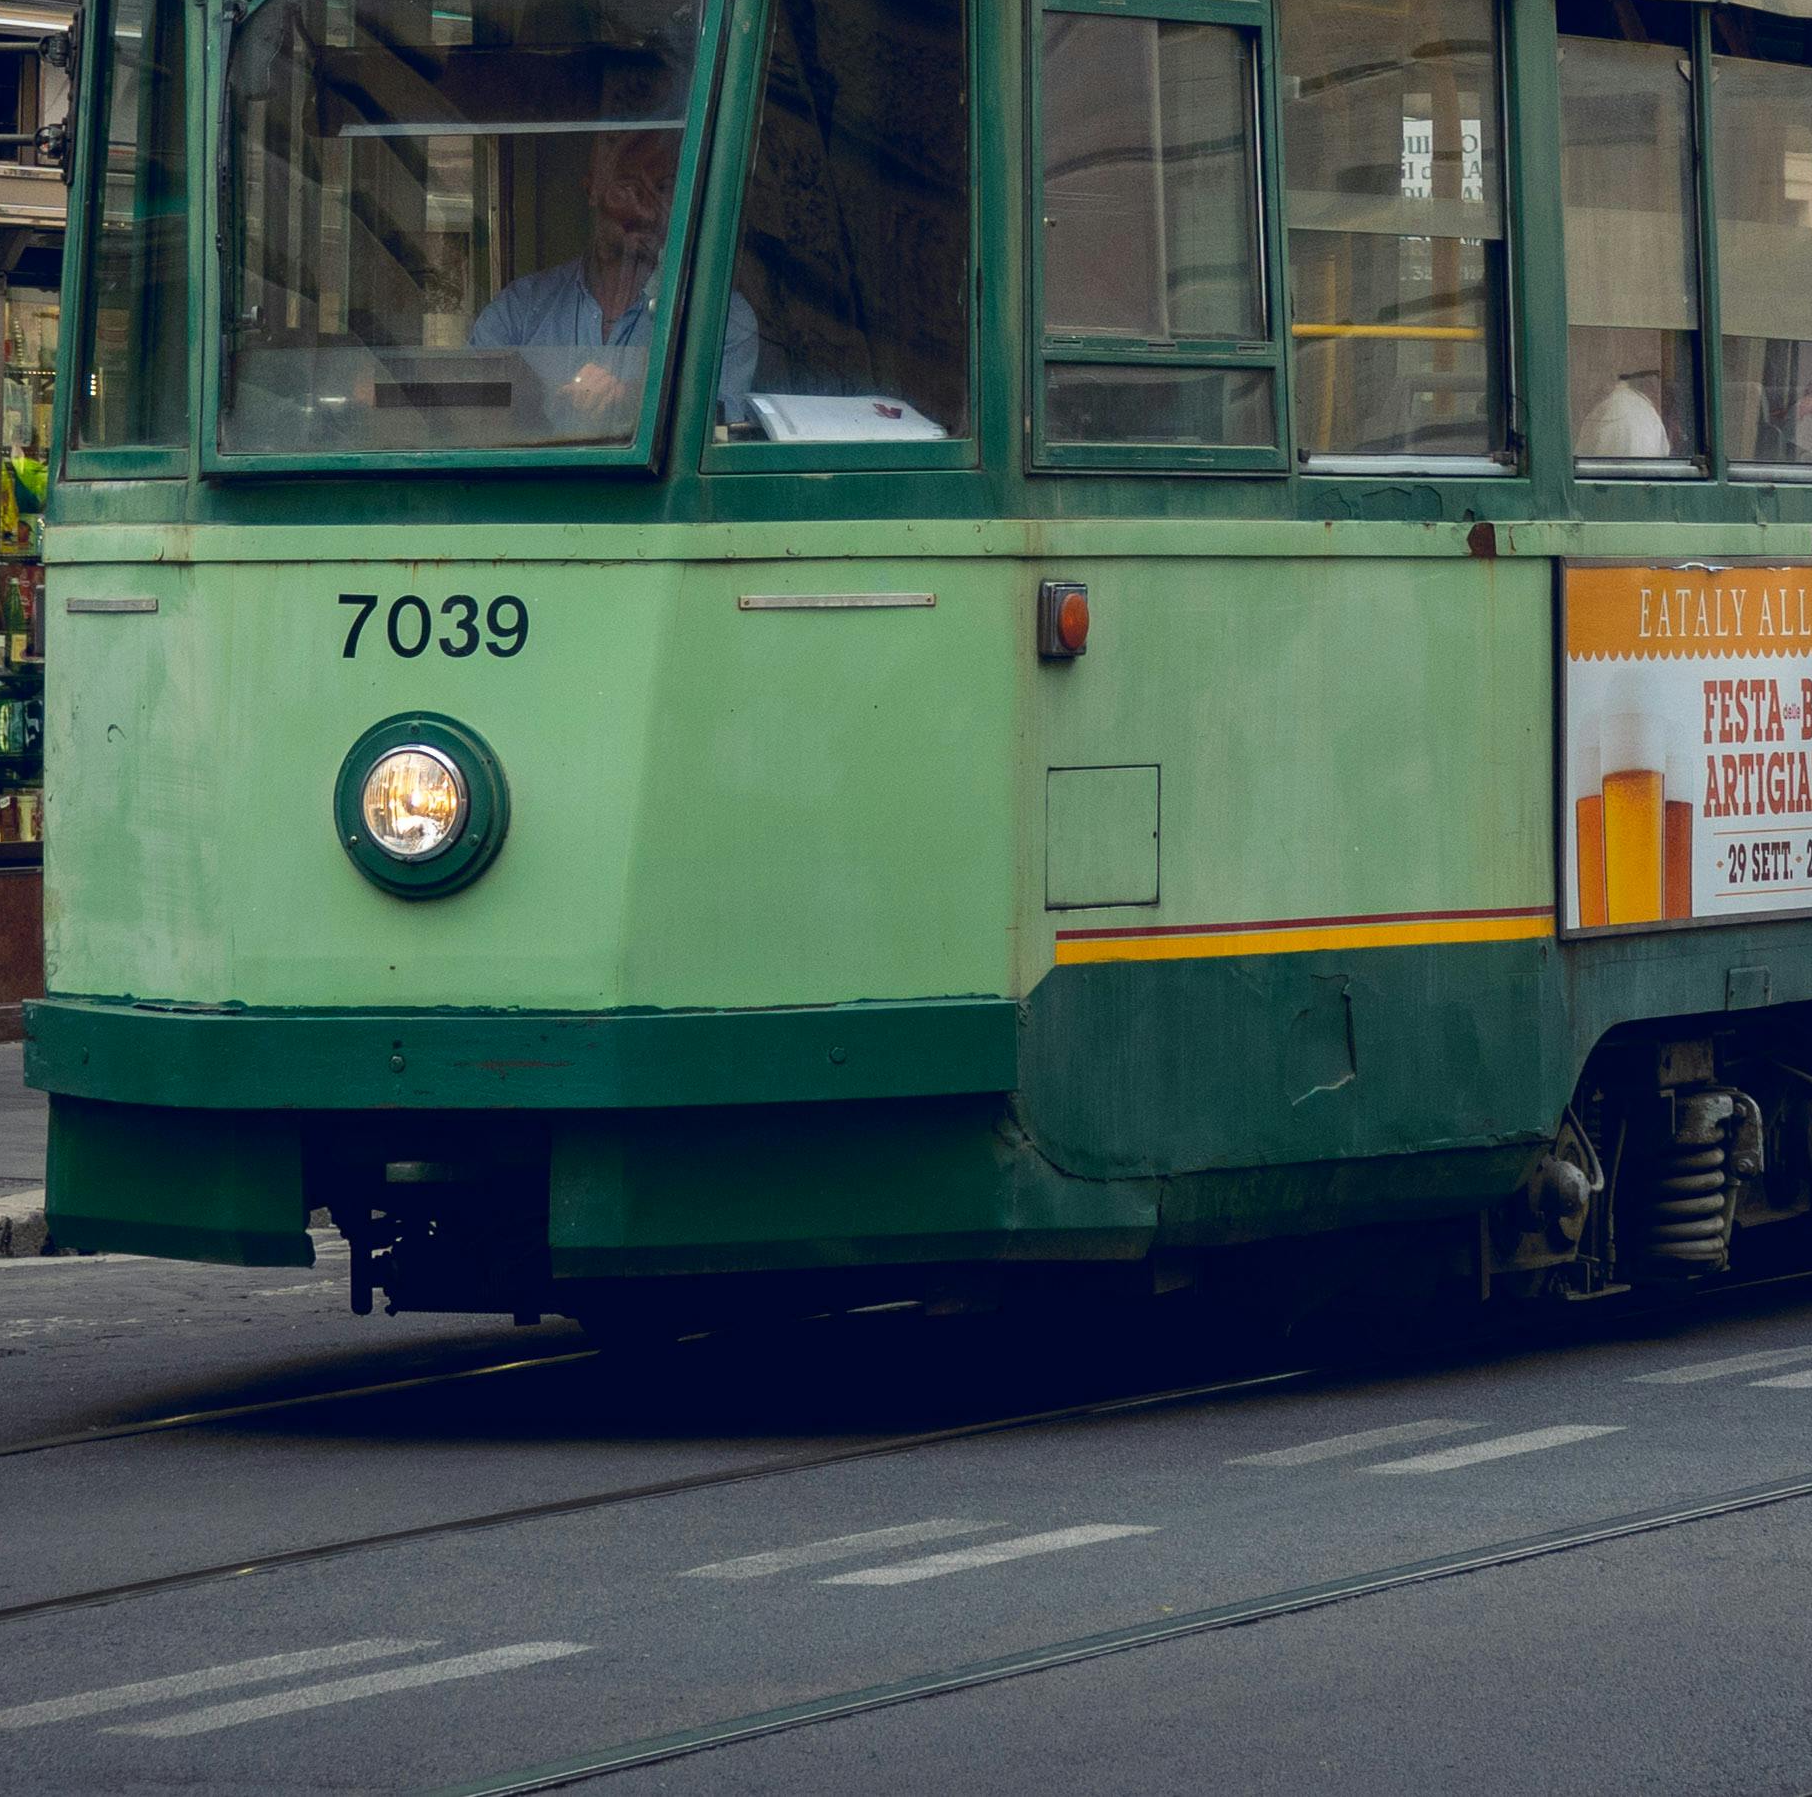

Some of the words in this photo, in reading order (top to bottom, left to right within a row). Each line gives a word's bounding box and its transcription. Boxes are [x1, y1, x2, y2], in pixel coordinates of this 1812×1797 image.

[337, 593, 530, 659] 7039
[1638, 588, 1747, 639] EATALY
[1702, 677, 1785, 744] FESTA
[1728, 843, 1747, 884] 29
[1751, 840, 1793, 883] SETT.
